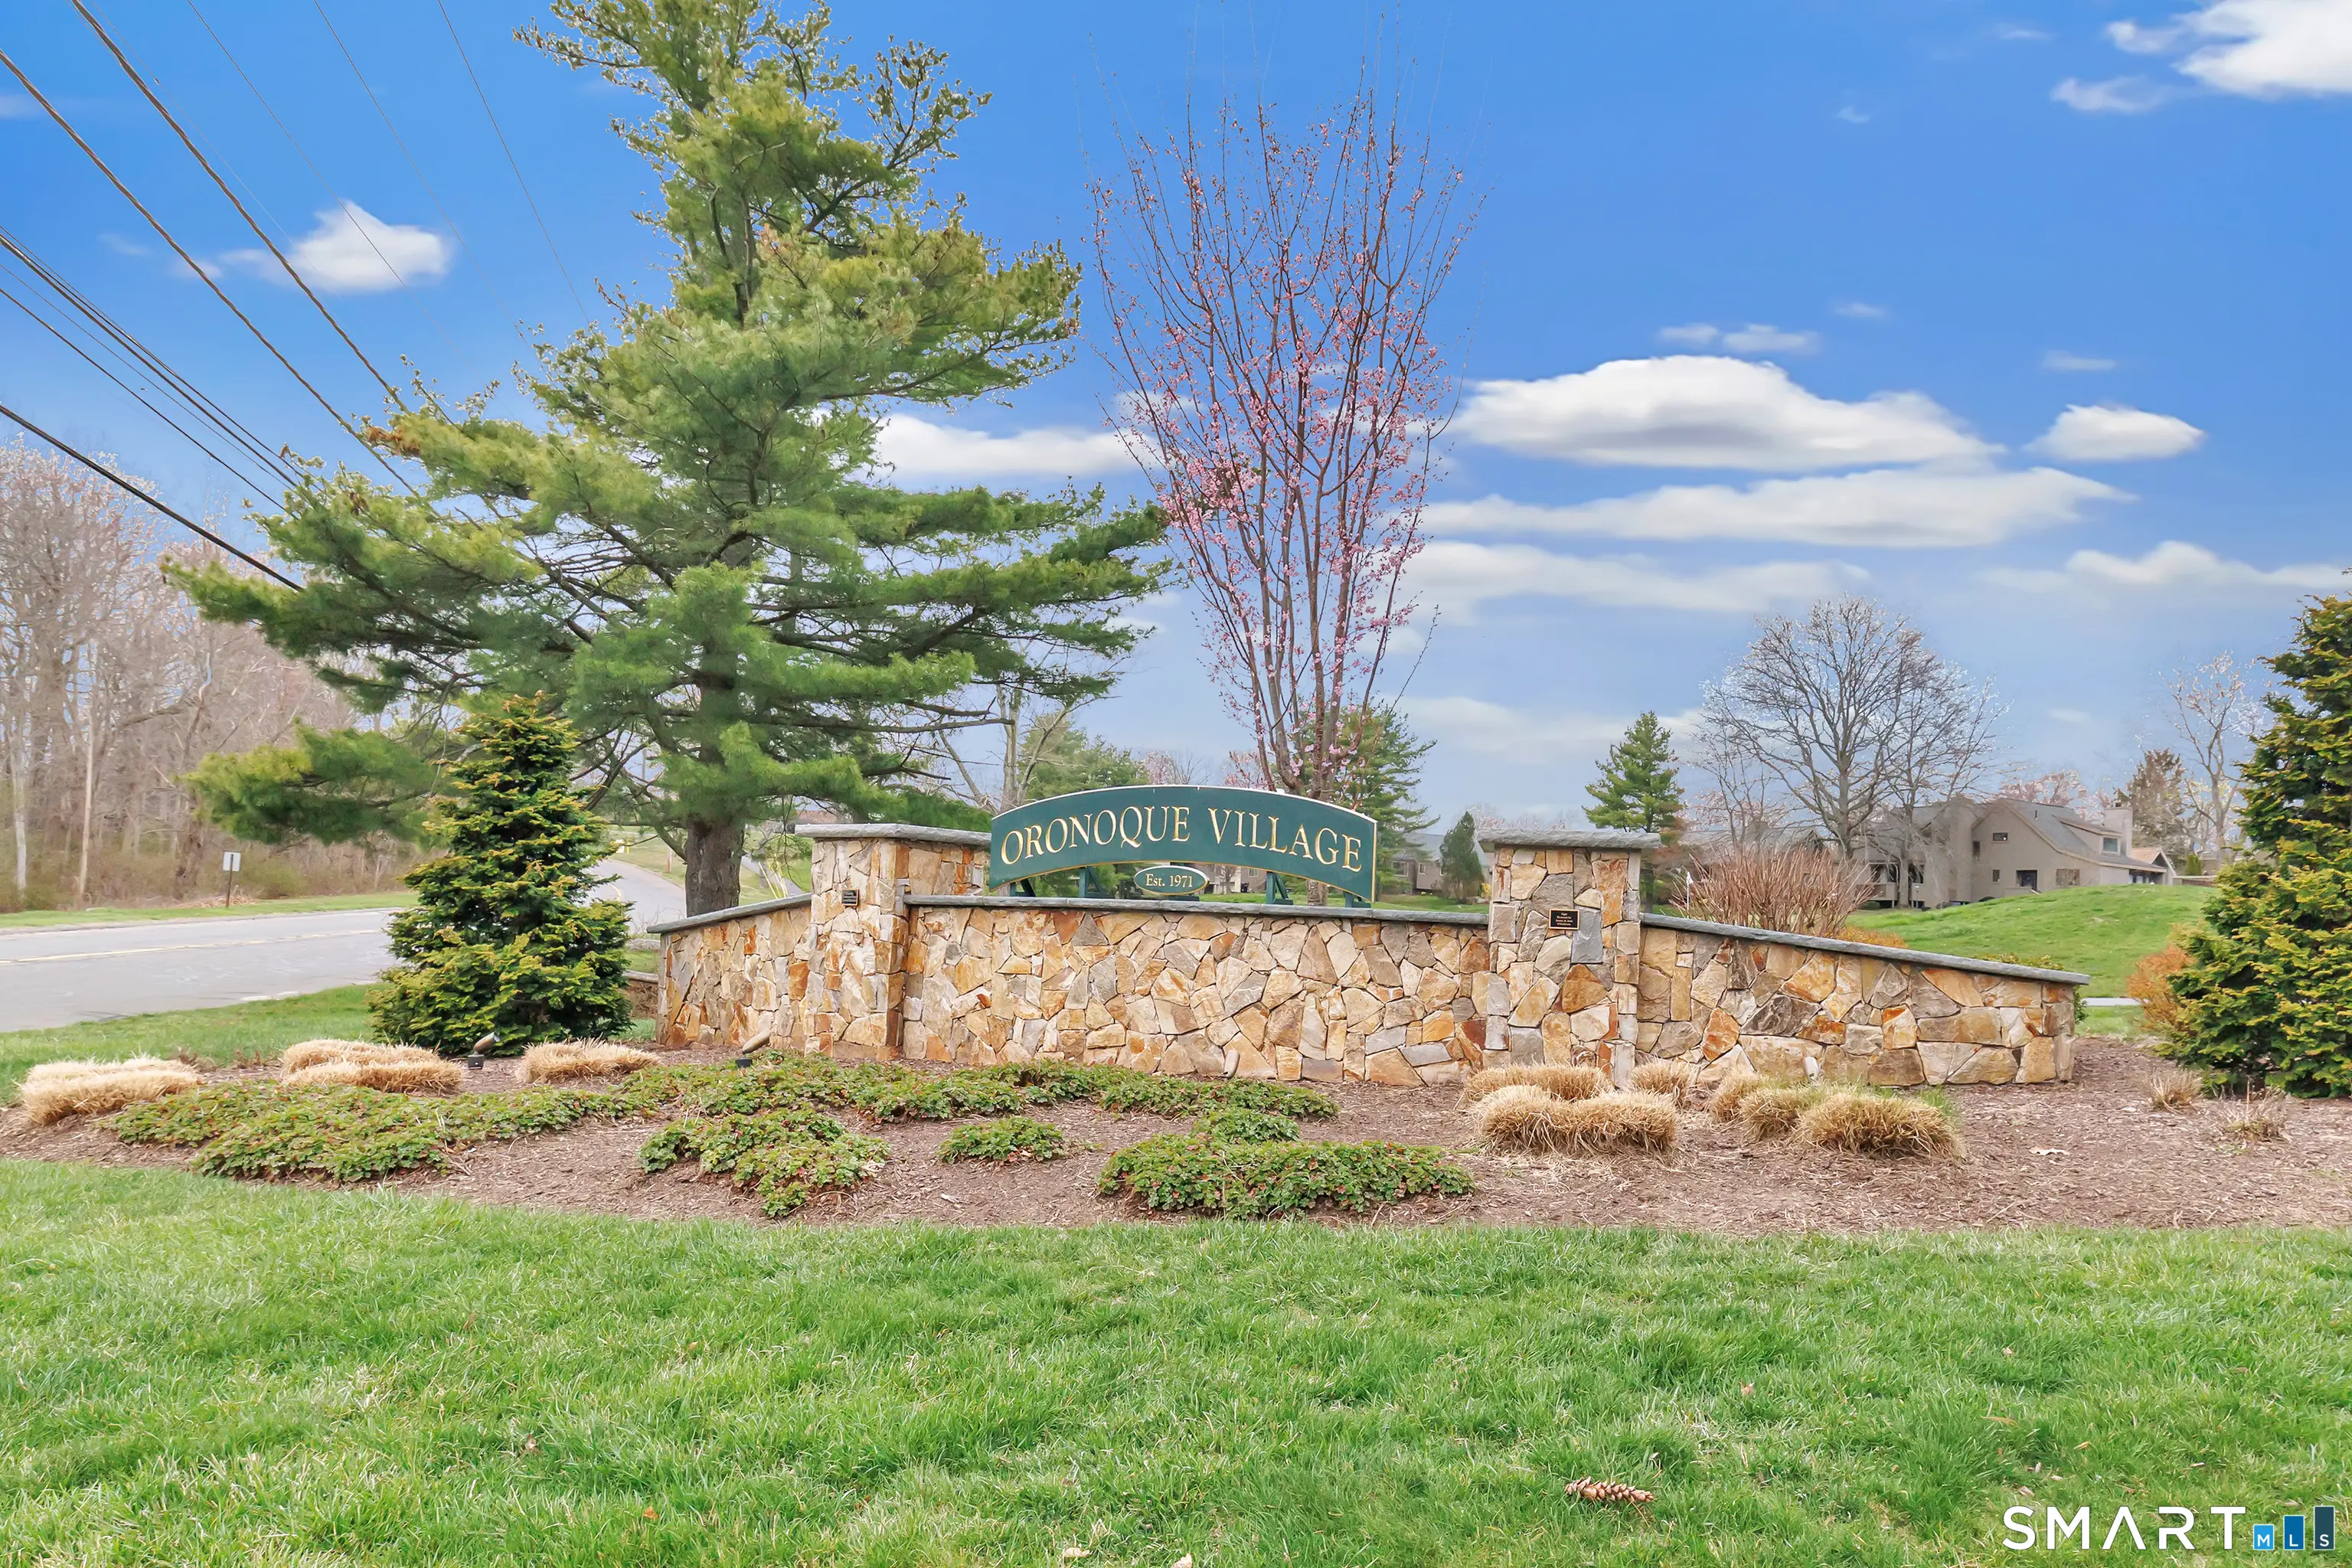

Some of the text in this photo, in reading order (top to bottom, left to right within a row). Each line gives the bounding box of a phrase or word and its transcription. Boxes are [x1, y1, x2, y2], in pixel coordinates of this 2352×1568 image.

[1000, 805, 1363, 873] ORONOQUE VILLAGE
[1145, 874, 1193, 888] Est. 1971
